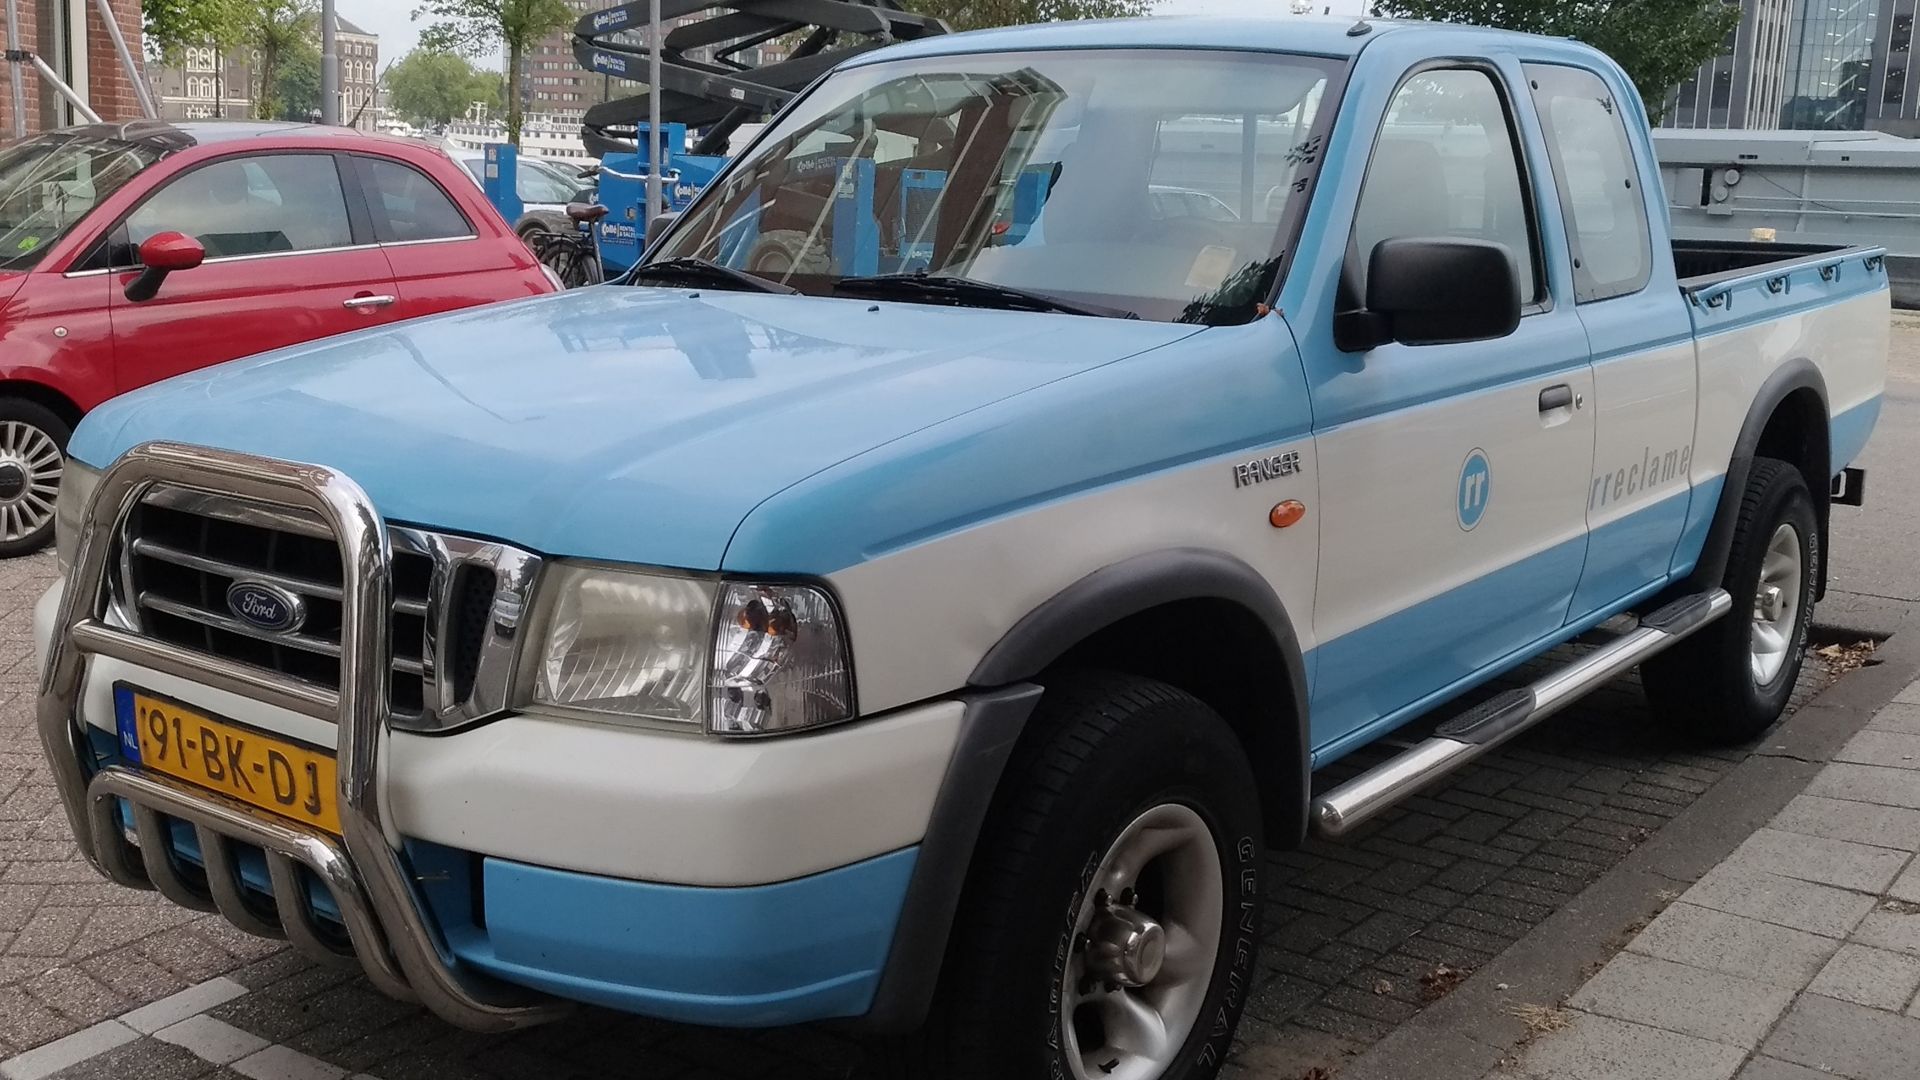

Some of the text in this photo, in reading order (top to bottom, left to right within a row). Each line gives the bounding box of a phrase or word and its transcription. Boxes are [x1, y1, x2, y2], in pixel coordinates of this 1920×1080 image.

[1233, 450, 1301, 488] RANGER
[1589, 445, 1690, 511] rreclame
[1463, 470, 1485, 510] rr
[242, 591, 276, 620] Ford
[123, 731, 138, 750] NL
[150, 709, 322, 815] 91-BK-DJ
[1197, 836, 1256, 1067] GENERAL
